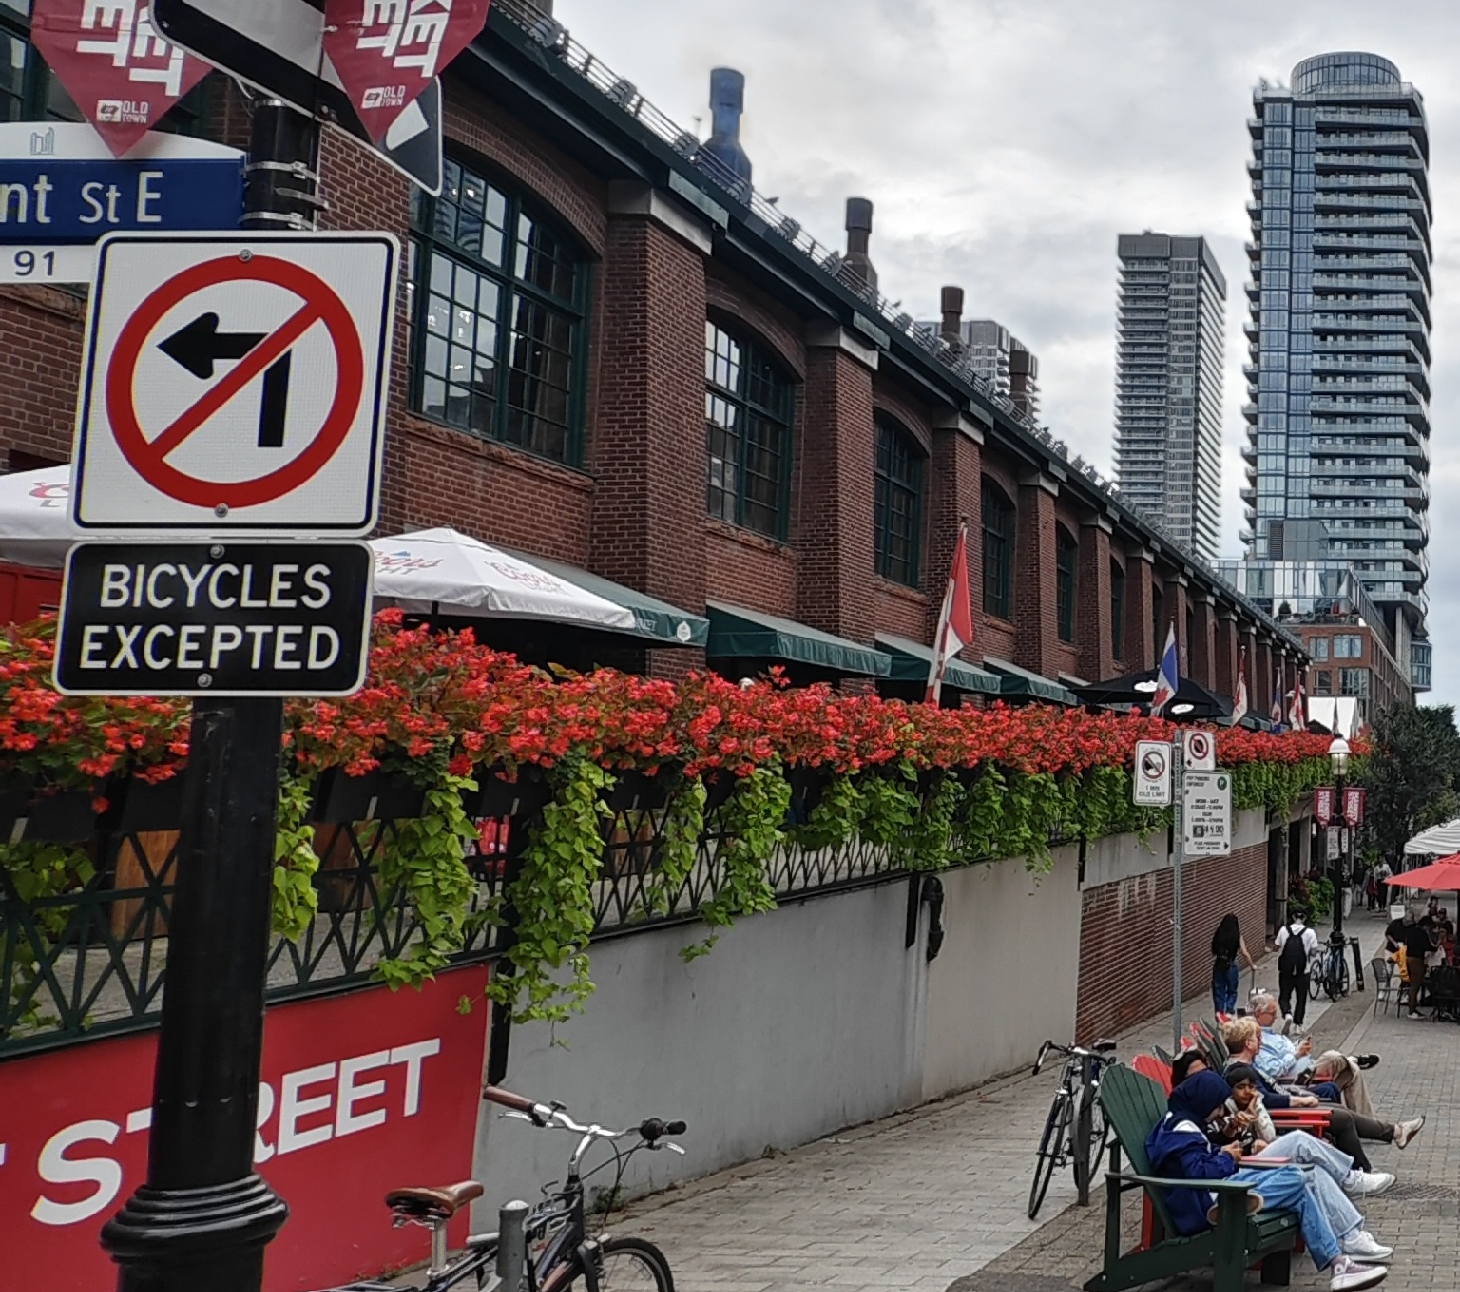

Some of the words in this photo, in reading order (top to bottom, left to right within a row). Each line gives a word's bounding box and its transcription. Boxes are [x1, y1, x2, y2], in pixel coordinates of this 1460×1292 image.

[380, 97, 404, 107] TOWN
[382, 85, 406, 99] OLD
[122, 113, 148, 124] TOWN
[123, 101, 149, 113] OLD
[78, 181, 122, 224] St
[136, 171, 164, 222] E
[14, 250, 55, 276] 91
[101, 563, 332, 608] BICYCLES
[79, 624, 339, 670] EXCEPTED
[30, 1038, 440, 1225] SEET
